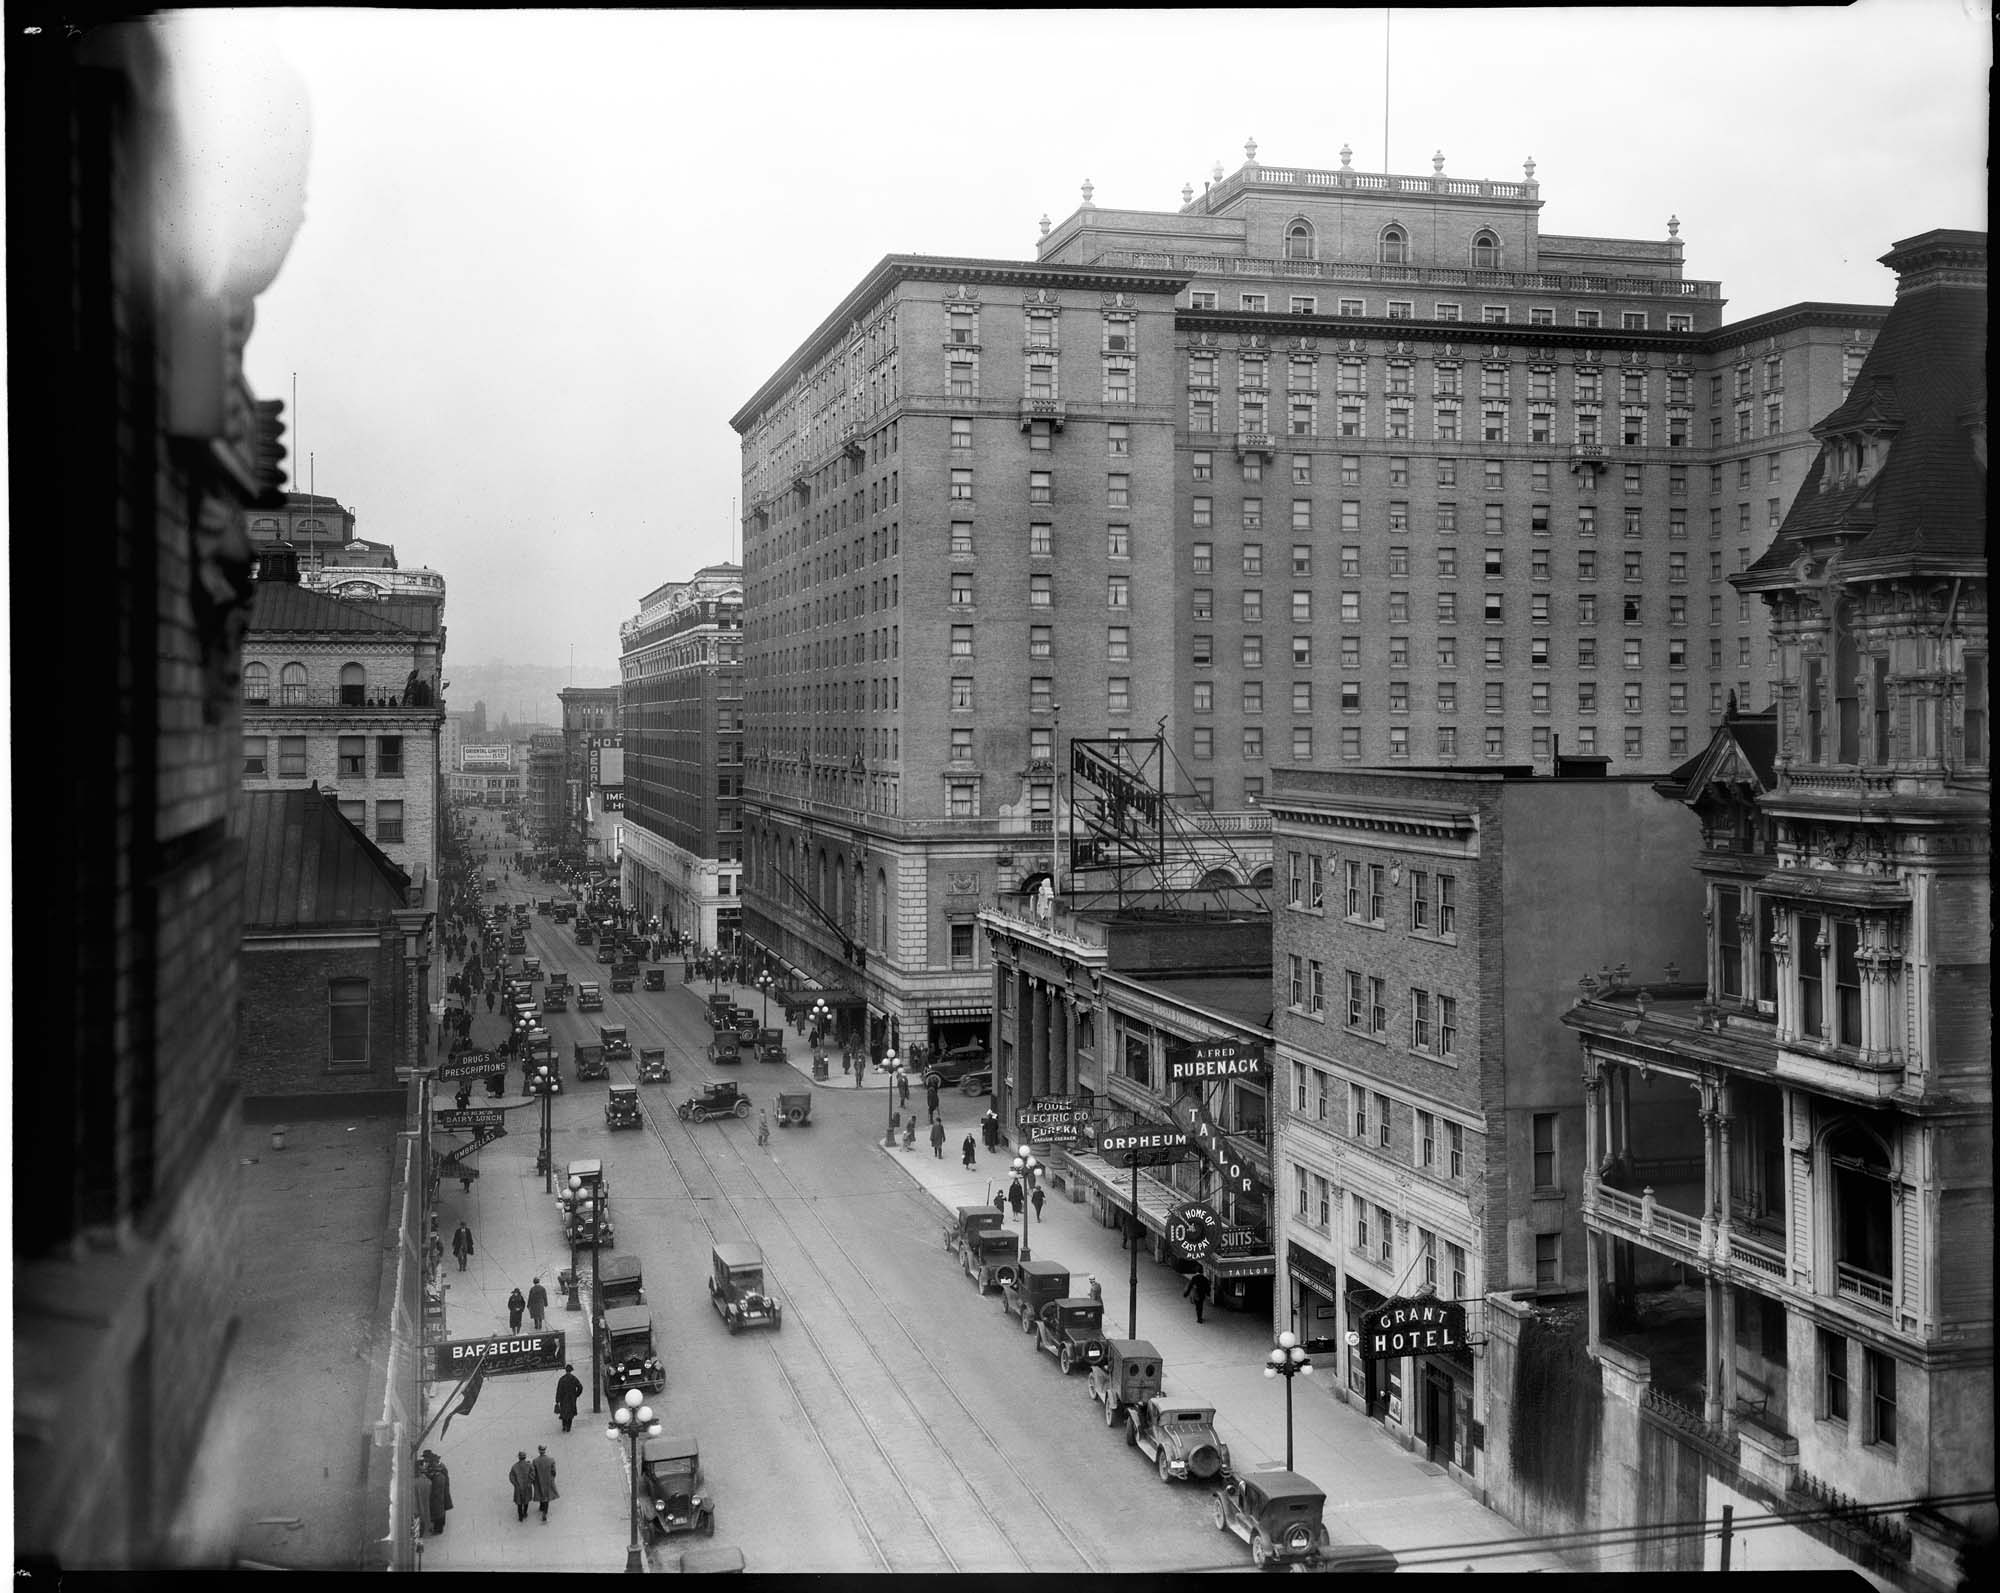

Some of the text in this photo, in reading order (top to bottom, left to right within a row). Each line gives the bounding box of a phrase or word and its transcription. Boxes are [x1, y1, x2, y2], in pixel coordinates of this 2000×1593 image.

[462, 1054, 490, 1065] DRUGS
[1208, 1048, 1235, 1057] FRED
[445, 1062, 506, 1077] PRESCRIPTIONS
[1173, 1059, 1258, 1077] RUBENACK
[446, 1116, 474, 1124] DAIRY
[1020, 1112, 1069, 1124] ELECTRIC
[1032, 1125, 1077, 1139] EUREKA
[454, 1133, 496, 1161] UMBRELLAS
[1103, 1134, 1187, 1149] ORPHEUM
[1188, 1108, 1252, 1191] TAILOR
[1185, 1208, 1216, 1227] HOME OF
[1170, 1224, 1186, 1242] 10
[1220, 1231, 1252, 1247] SUITS
[1181, 1237, 1211, 1252] EASY PAY
[1186, 1252, 1206, 1260] PLAN
[1229, 1267, 1269, 1276] TAILOR
[1380, 1307, 1447, 1329] GRANT
[1375, 1328, 1454, 1352] HOTEL
[452, 1339, 543, 1359] BARBECUE
